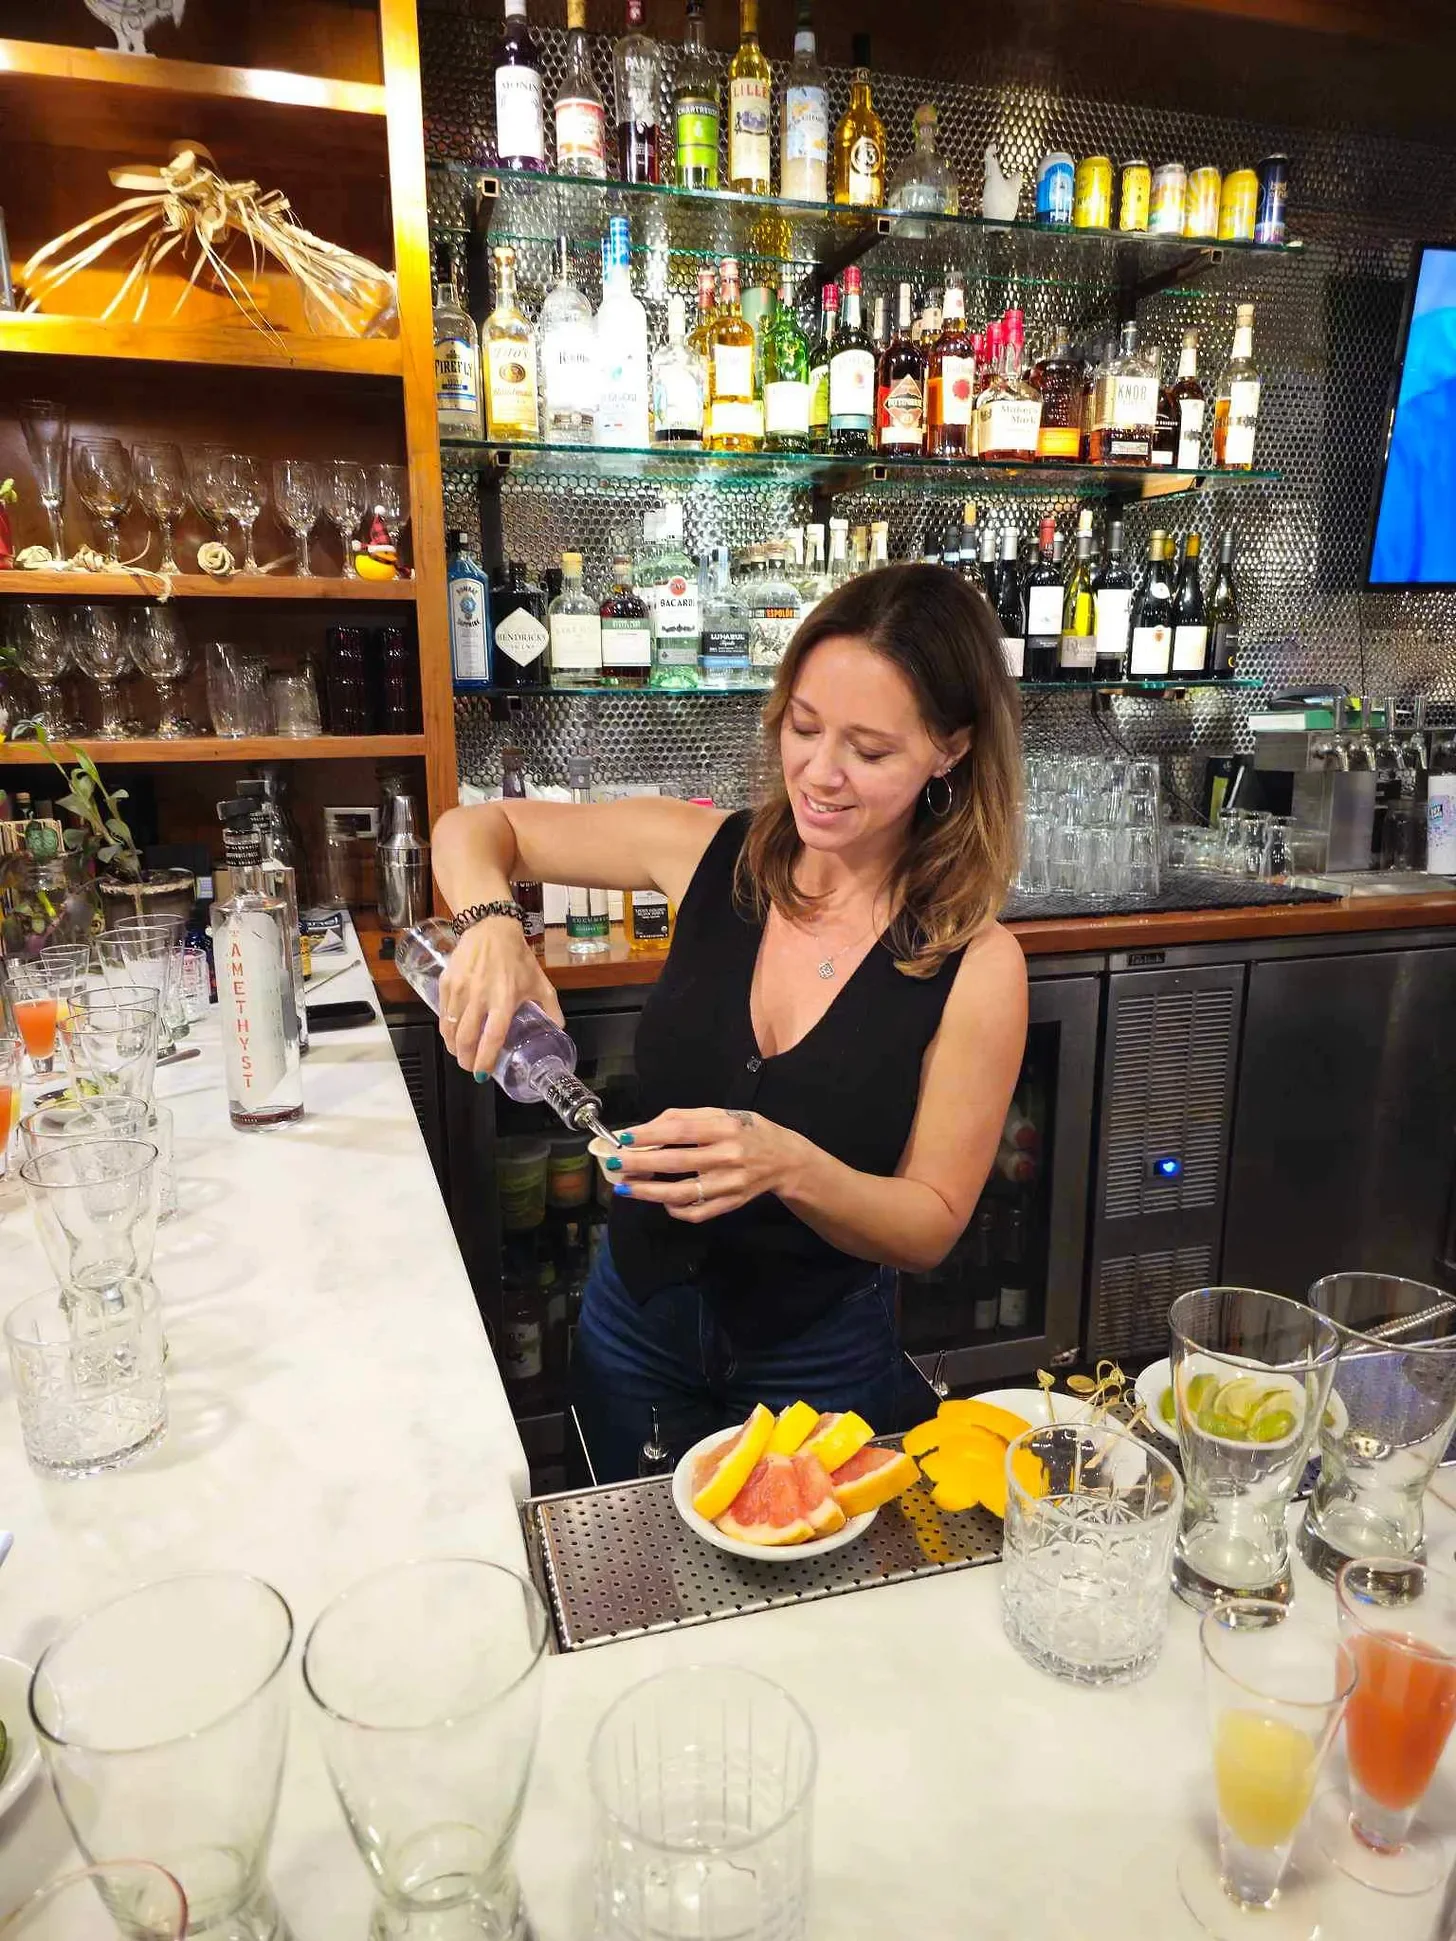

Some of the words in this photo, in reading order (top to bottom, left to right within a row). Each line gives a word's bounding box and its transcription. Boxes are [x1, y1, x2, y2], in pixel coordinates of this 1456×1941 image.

[434, 359, 473, 379] FIREFLY
[660, 597, 695, 608] BACARDI
[230, 941, 253, 1089] AMETHYST
